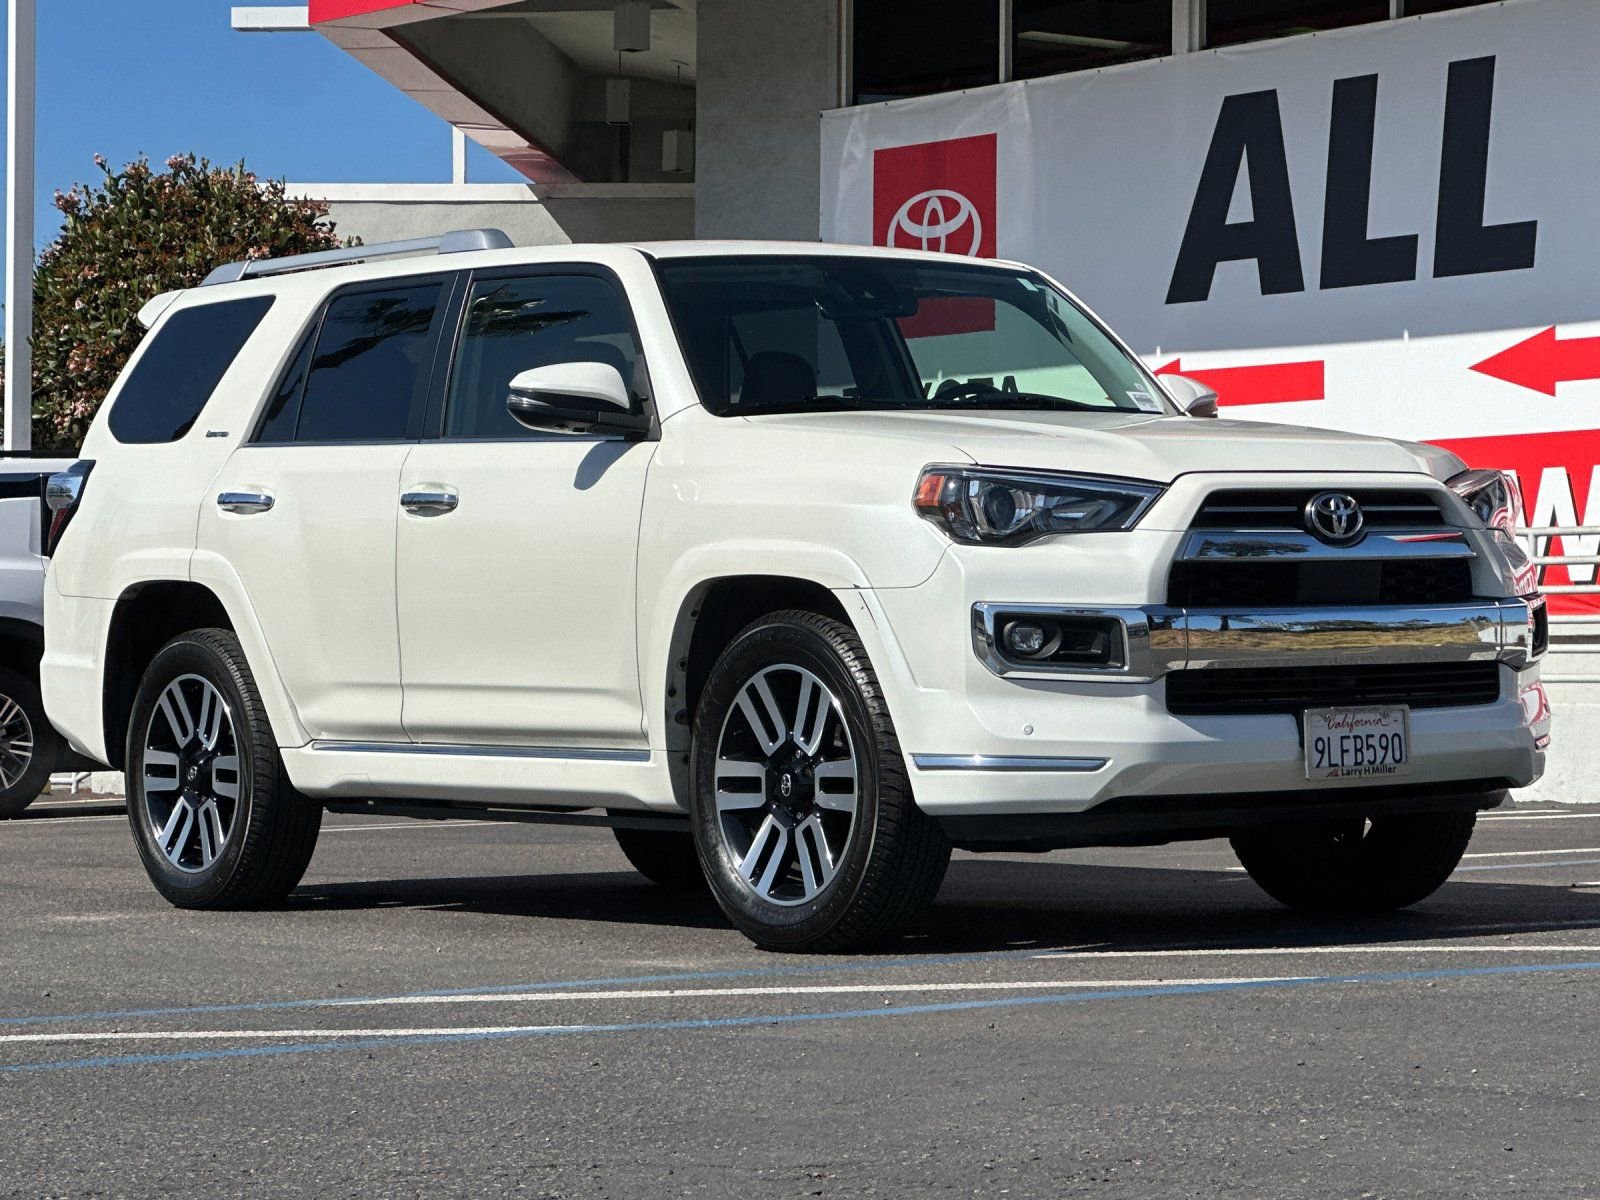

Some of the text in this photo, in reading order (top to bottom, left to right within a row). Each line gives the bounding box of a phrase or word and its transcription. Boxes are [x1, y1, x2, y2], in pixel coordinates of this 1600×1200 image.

[1165, 55, 1538, 304] ALL
[1327, 713, 1388, 732] California
[1314, 732, 1403, 768] 9LFB590
[1341, 765, 1397, 777] Larry H Miller
